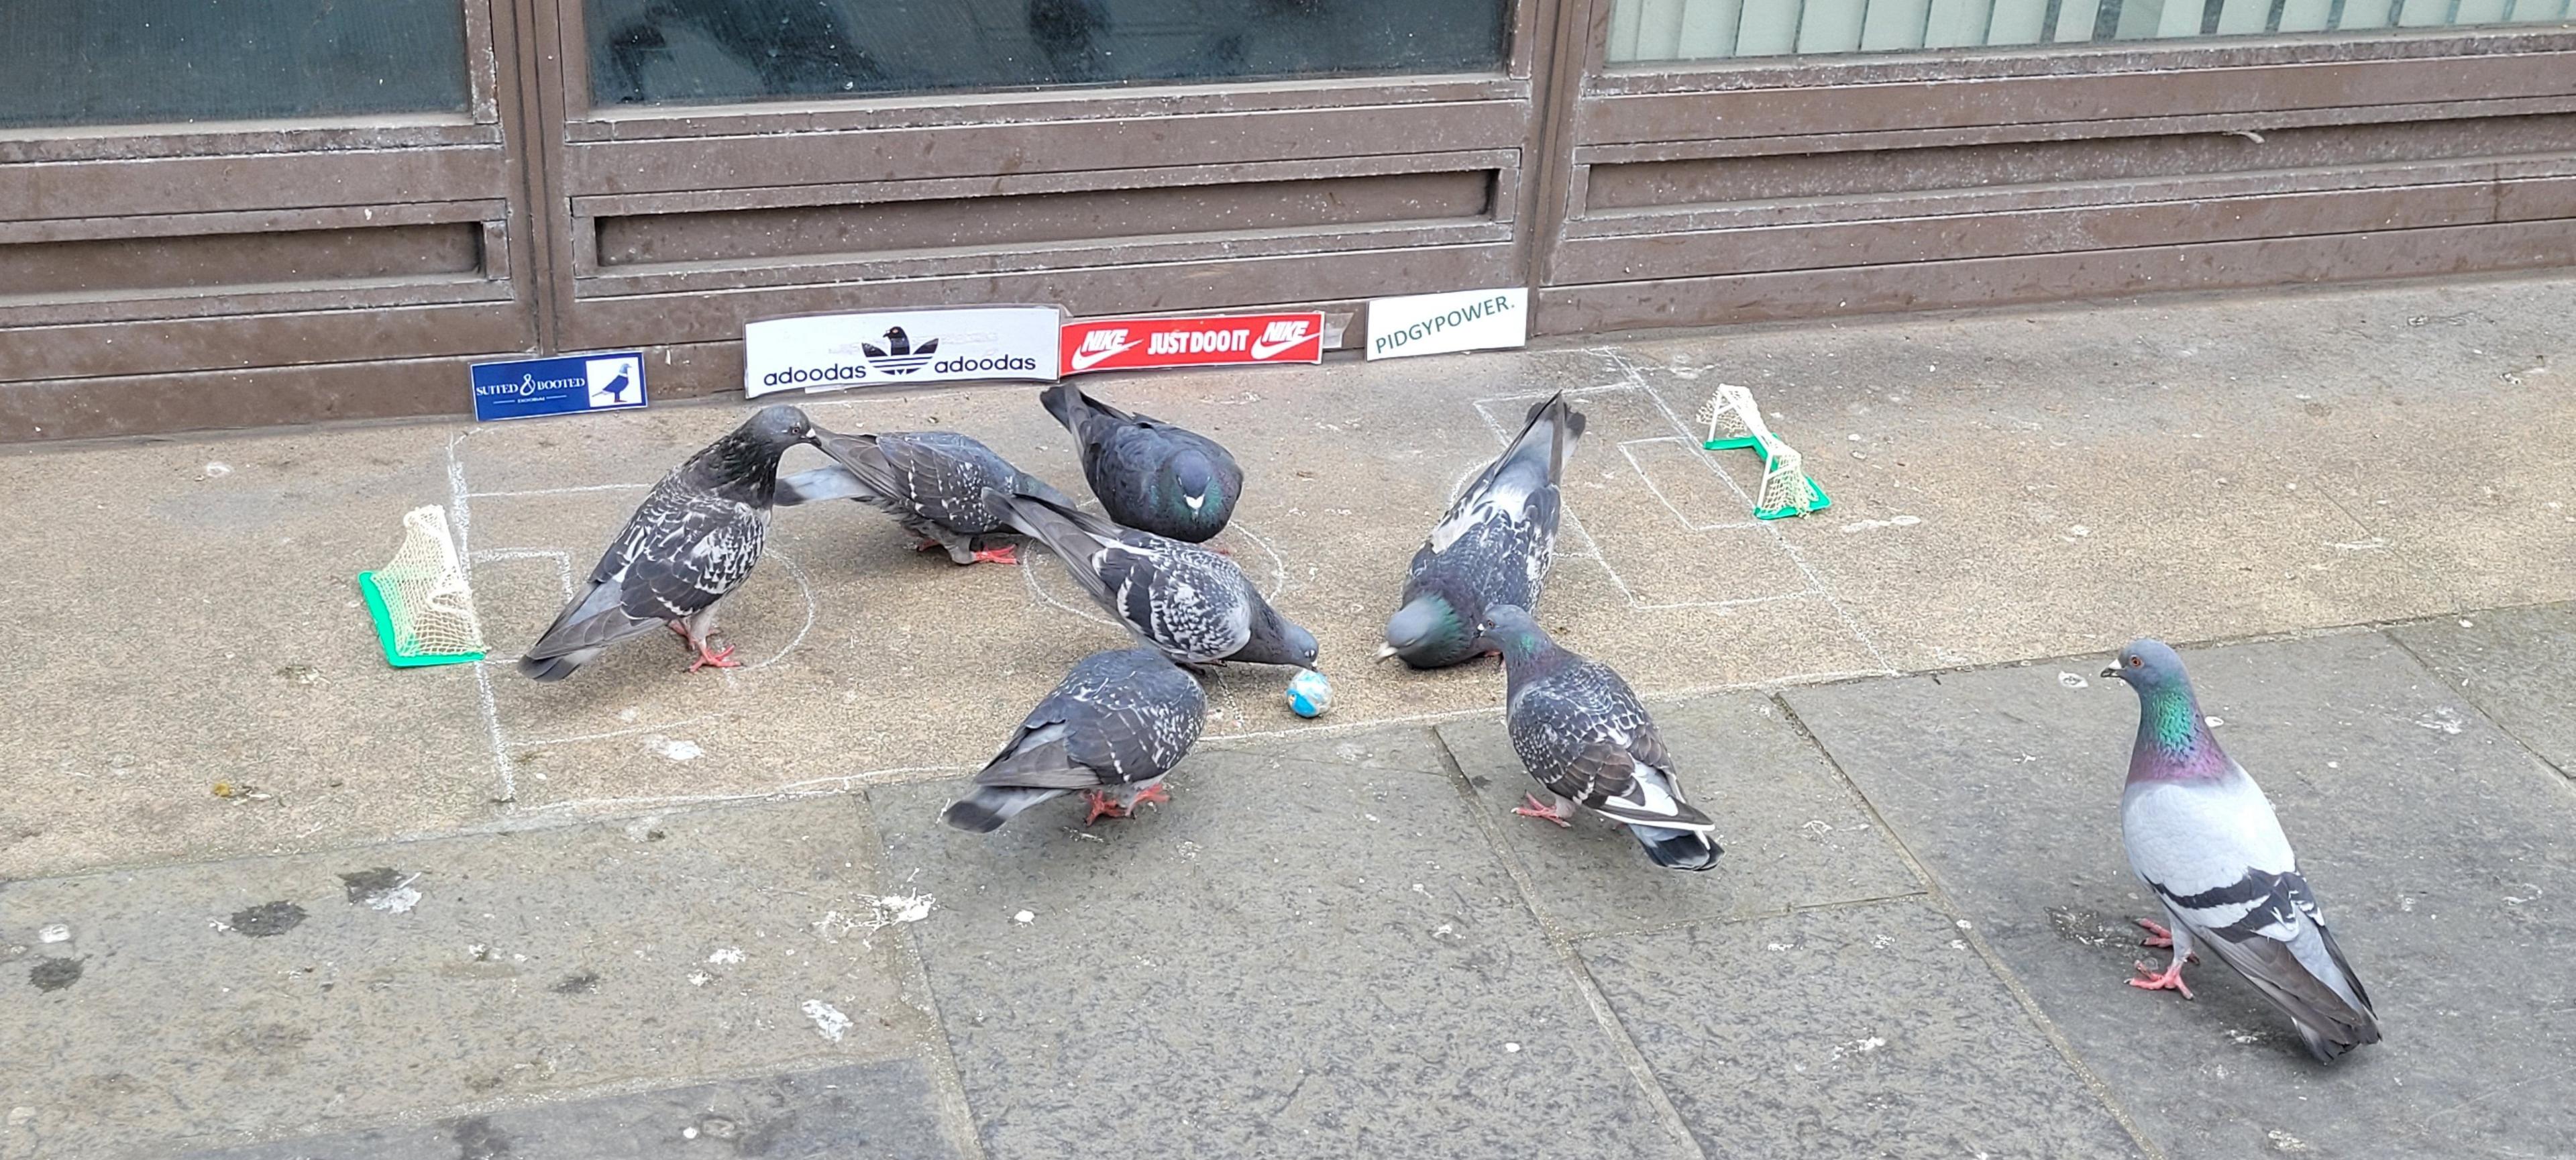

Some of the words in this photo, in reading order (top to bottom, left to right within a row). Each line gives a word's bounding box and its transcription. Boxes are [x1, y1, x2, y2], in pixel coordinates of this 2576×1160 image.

[1080, 328, 1129, 353] NIKE
[1147, 330, 1191, 355] JUST
[1189, 329, 1231, 354] DOO
[1230, 328, 1250, 351] IT
[1260, 321, 1310, 343] NIKE
[1375, 295, 1515, 354] PIDGYPOWER.
[476, 383, 519, 396] SUITED
[519, 373, 536, 396] &
[537, 377, 586, 391] BOOTED
[763, 363, 866, 386] adoodas
[934, 354, 1036, 374] adoodas
